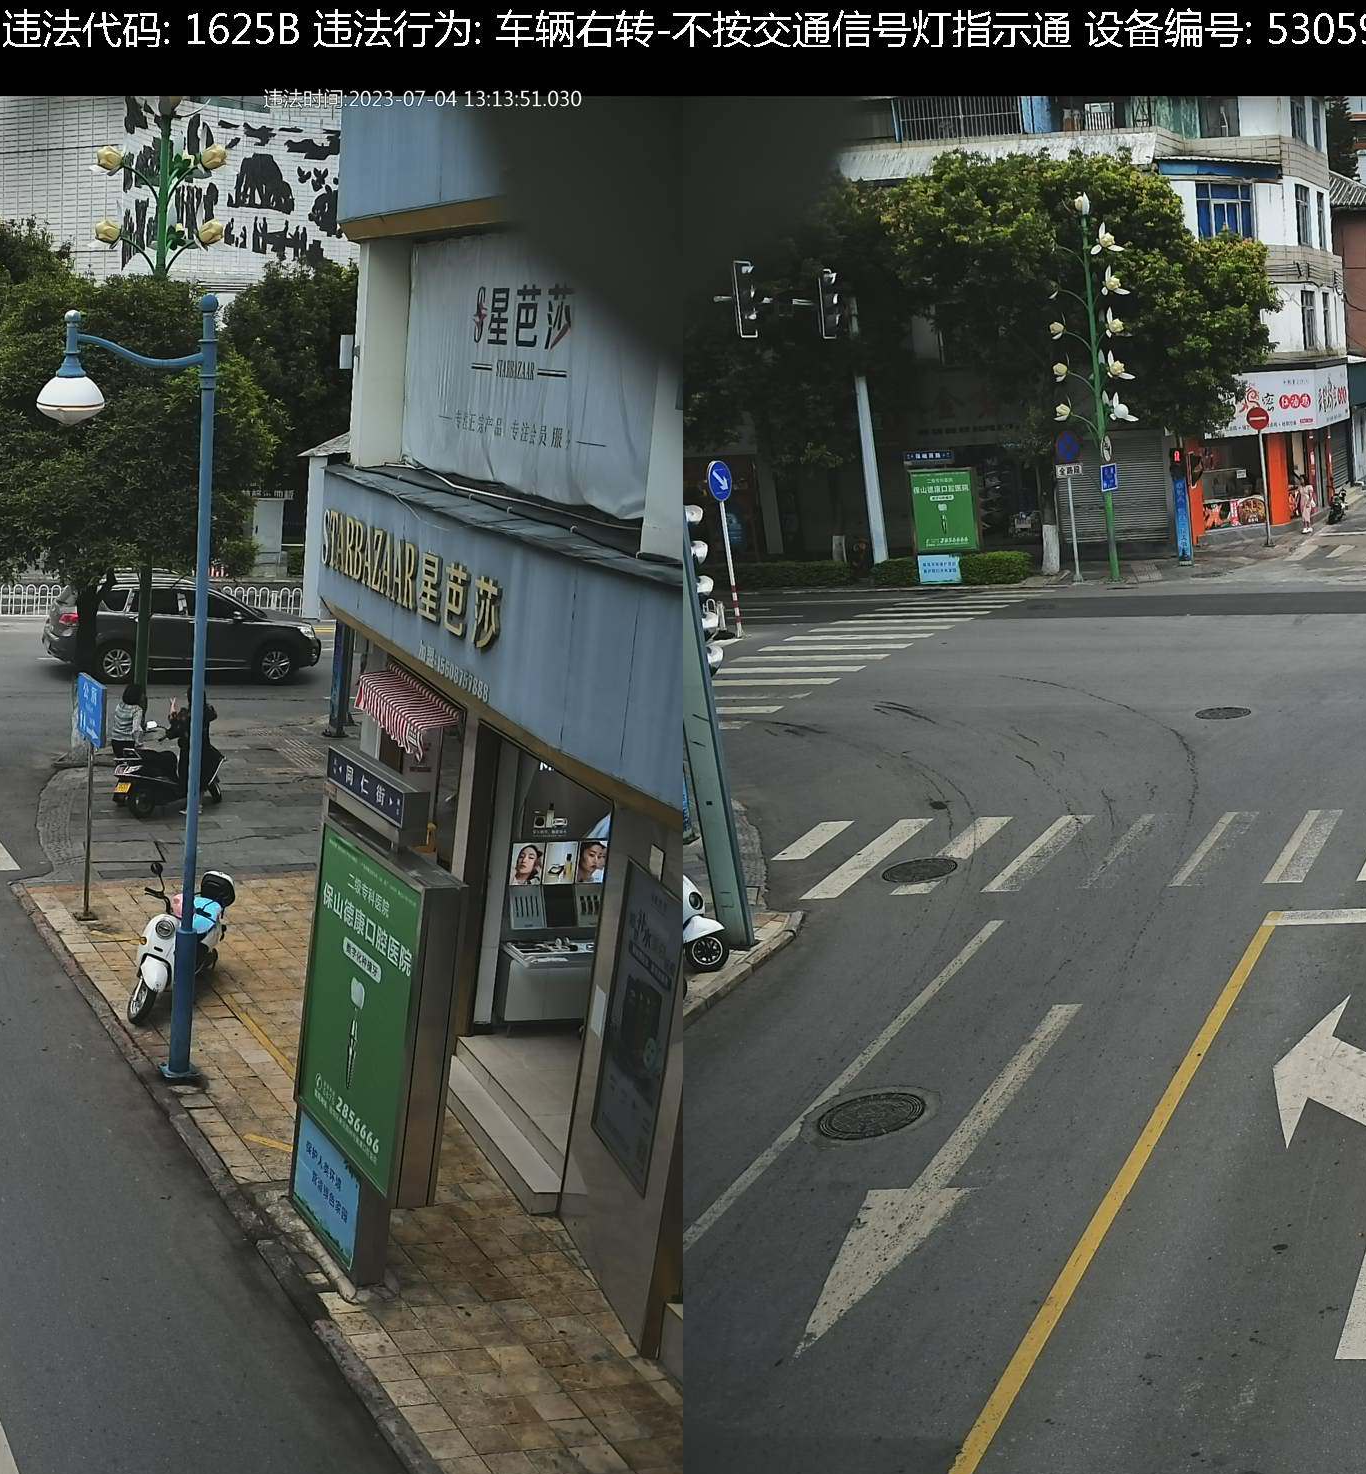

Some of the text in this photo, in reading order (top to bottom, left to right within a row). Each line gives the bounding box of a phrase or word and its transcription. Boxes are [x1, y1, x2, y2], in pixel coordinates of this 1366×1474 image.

[487, 282, 575, 351] 星芭莎
[321, 508, 502, 650] STARBAZAAR 星芭莎
[345, 764, 386, 807] 同仁街
[347, 872, 390, 919] 二级专科医院
[323, 882, 413, 977] 保山德康口腔医院
[335, 1095, 380, 1155] 2856666
